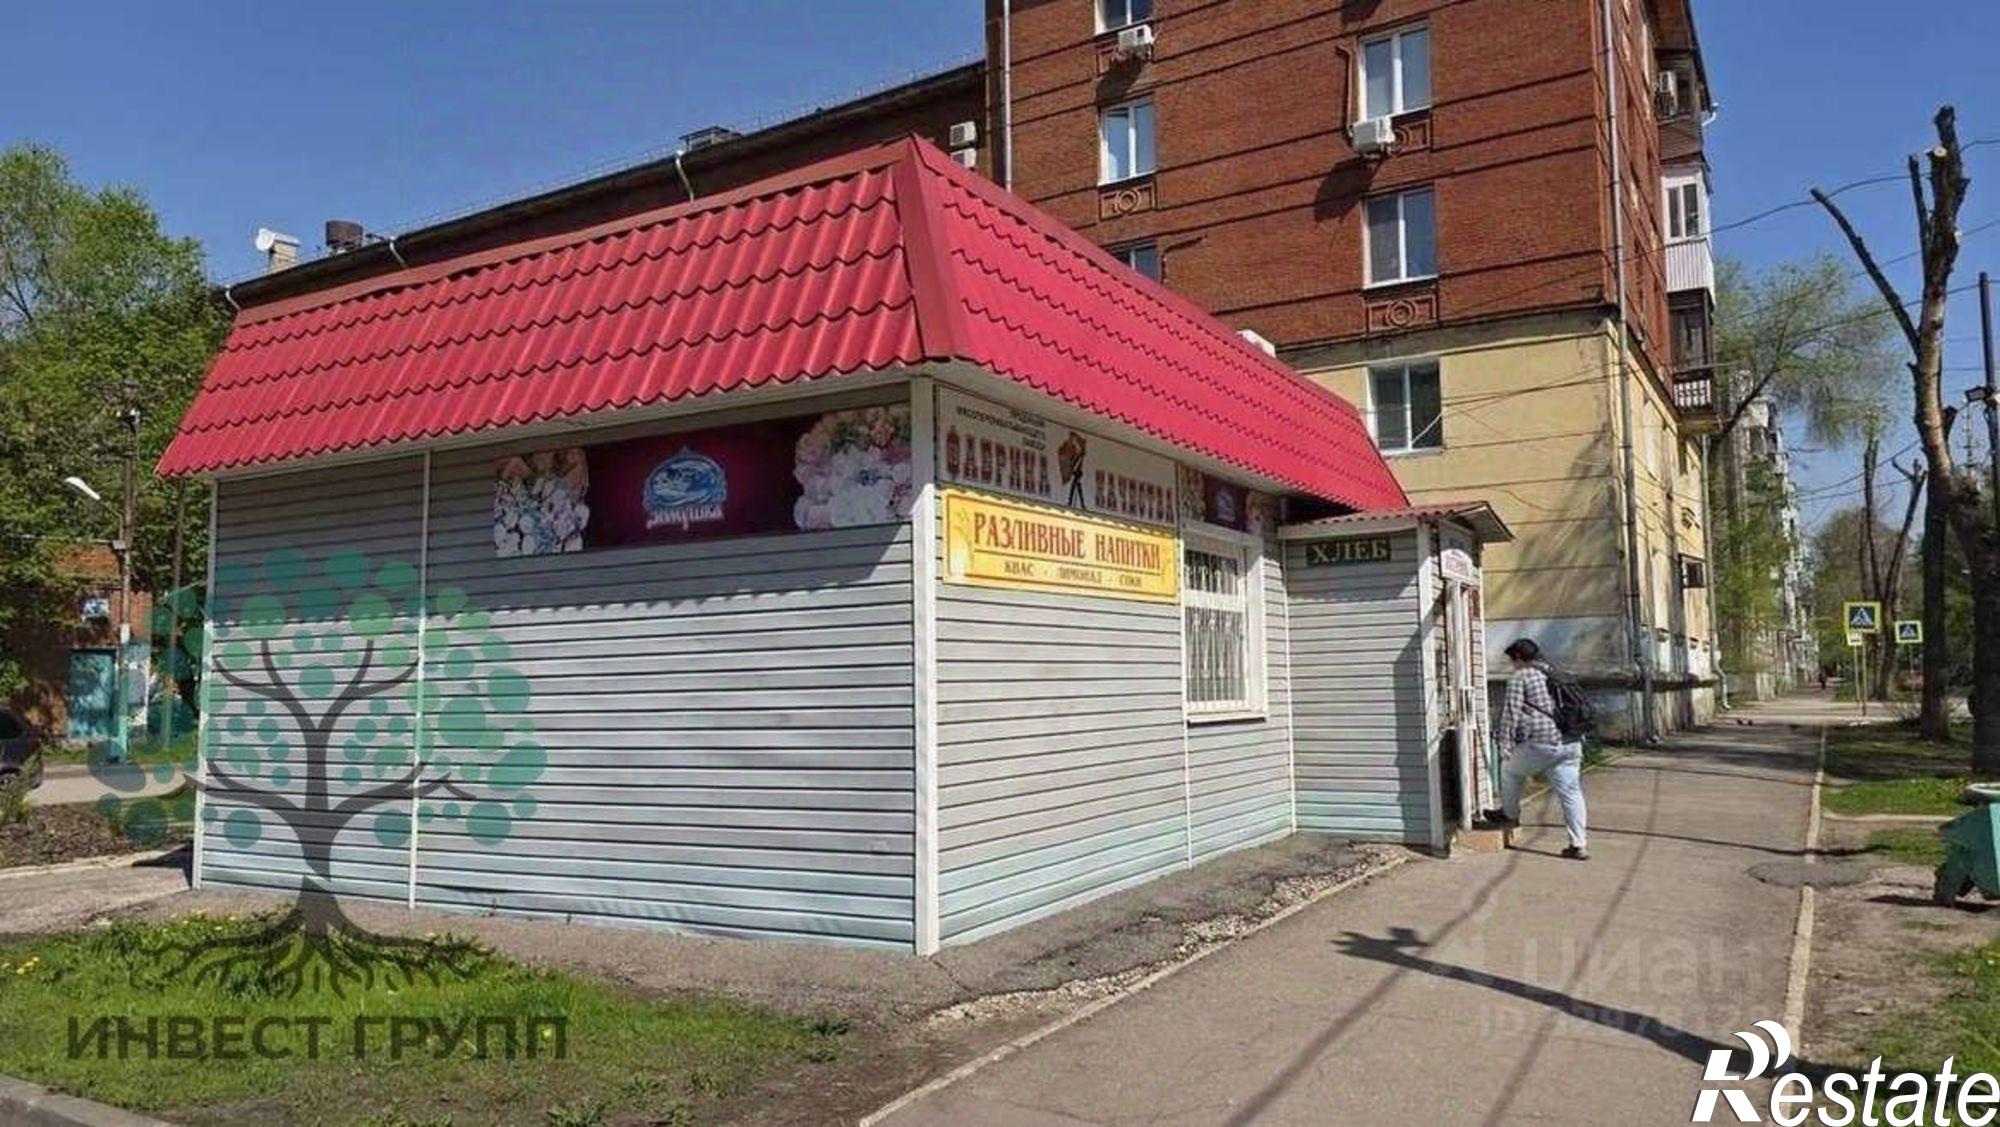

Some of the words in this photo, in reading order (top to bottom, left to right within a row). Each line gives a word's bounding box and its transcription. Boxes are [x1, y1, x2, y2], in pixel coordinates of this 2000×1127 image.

[946, 425, 1052, 495] ФАБРИКА
[974, 512, 1087, 560] РАЗЛИВНЫЕ
[1095, 533, 1162, 571] НАПИТКИ
[1311, 538, 1388, 564] ХЛЕБ
[1004, 562, 1035, 577] КВАС
